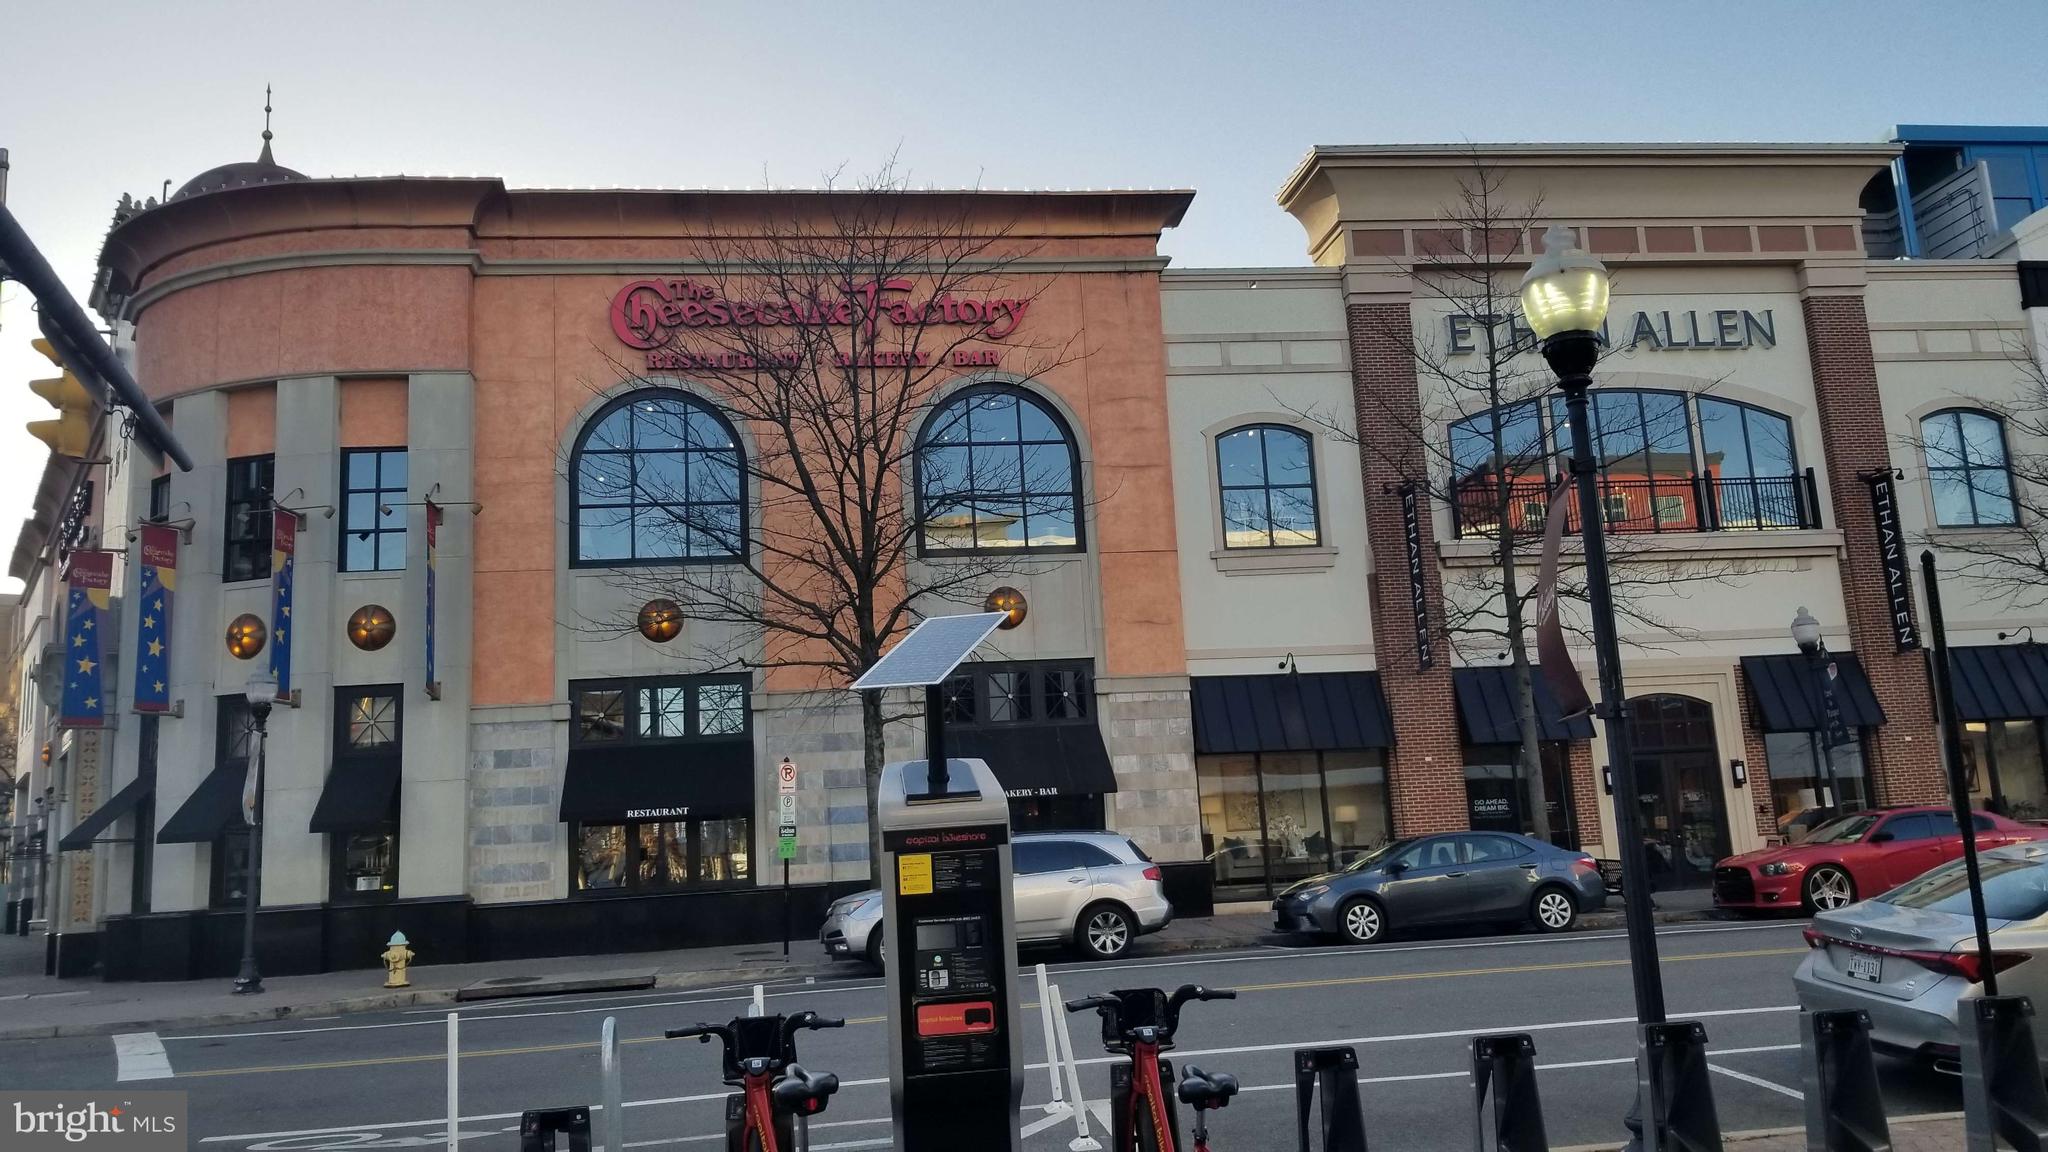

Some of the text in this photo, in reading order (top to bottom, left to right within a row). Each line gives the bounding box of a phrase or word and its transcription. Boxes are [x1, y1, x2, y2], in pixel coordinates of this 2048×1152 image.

[669, 279, 714, 301] The
[610, 278, 1030, 350] Cheesecake Factory
[1447, 309, 1777, 352] ETHN ALLEN
[952, 351, 1000, 367] BAR
[1405, 493, 1430, 662] ETHAN ALLEN
[1875, 481, 1913, 644] ETHAN ALLEN
[1039, 787, 1058, 796] BAR
[627, 806, 689, 818] RESTAURANT
